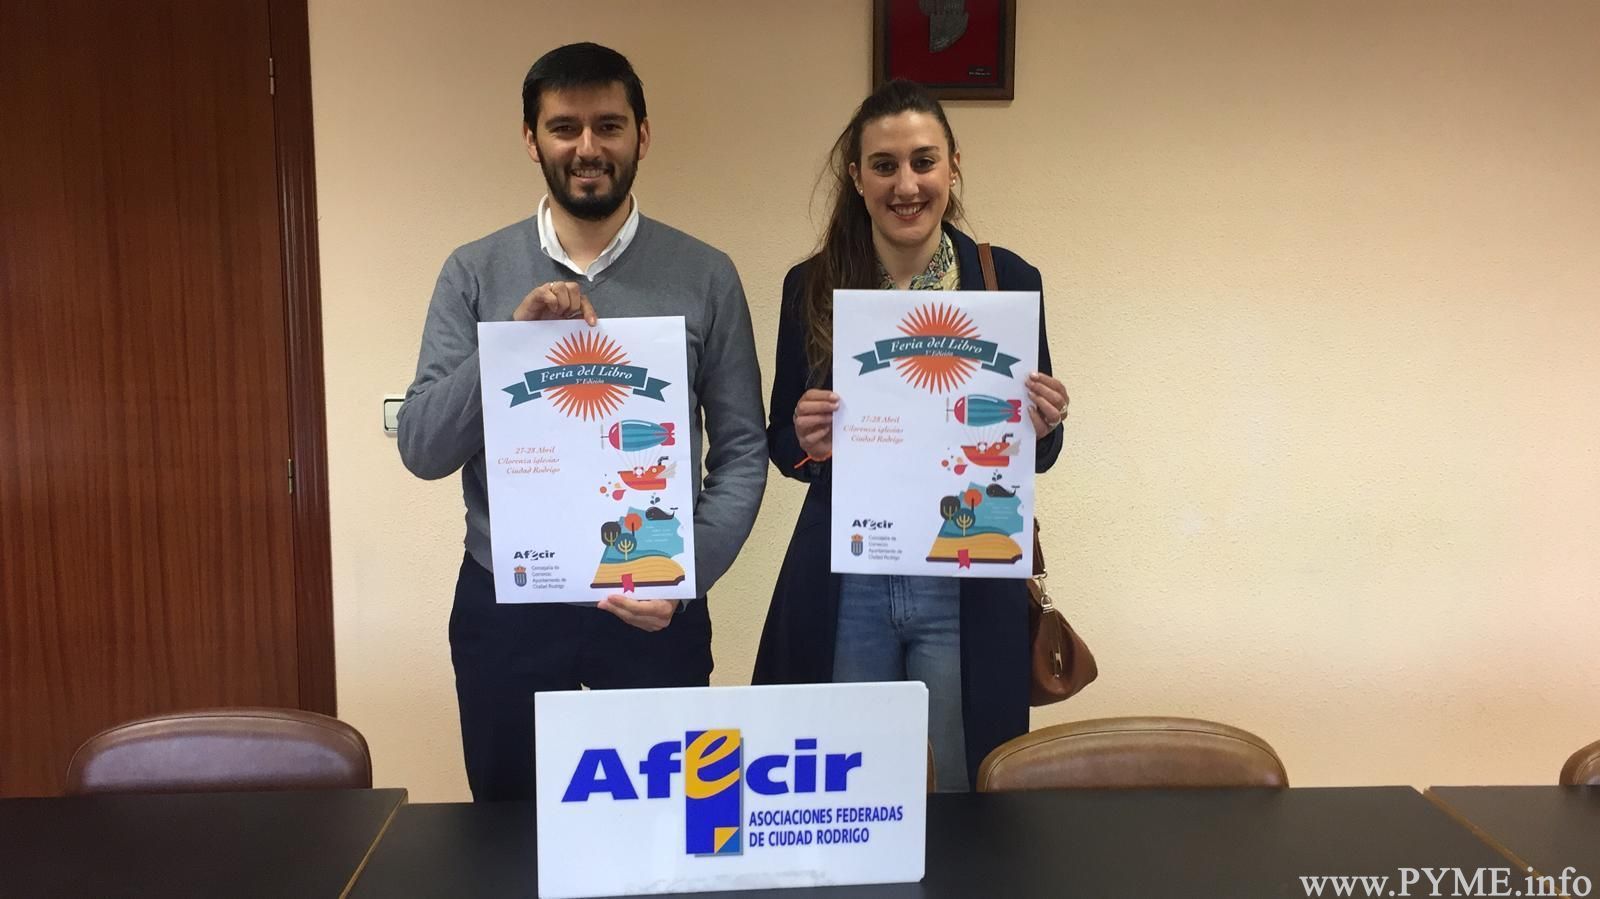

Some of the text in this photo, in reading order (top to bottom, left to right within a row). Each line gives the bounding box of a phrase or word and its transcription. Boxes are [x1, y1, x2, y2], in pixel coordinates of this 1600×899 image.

[891, 337, 983, 354] Feria del Libro
[541, 365, 633, 384] Feria del Libro
[851, 435, 905, 445] Ciudad Rodrigo
[537, 446, 556, 454] Abril
[506, 466, 561, 475] Ciudad Rodrigo
[852, 518, 894, 531] Afecir
[513, 549, 556, 561] Afecir
[561, 728, 863, 803] Afecir
[749, 806, 904, 827] ASOCIACIONES FEDERADAS
[749, 827, 870, 848] DE CIUDAD RODRIGO
